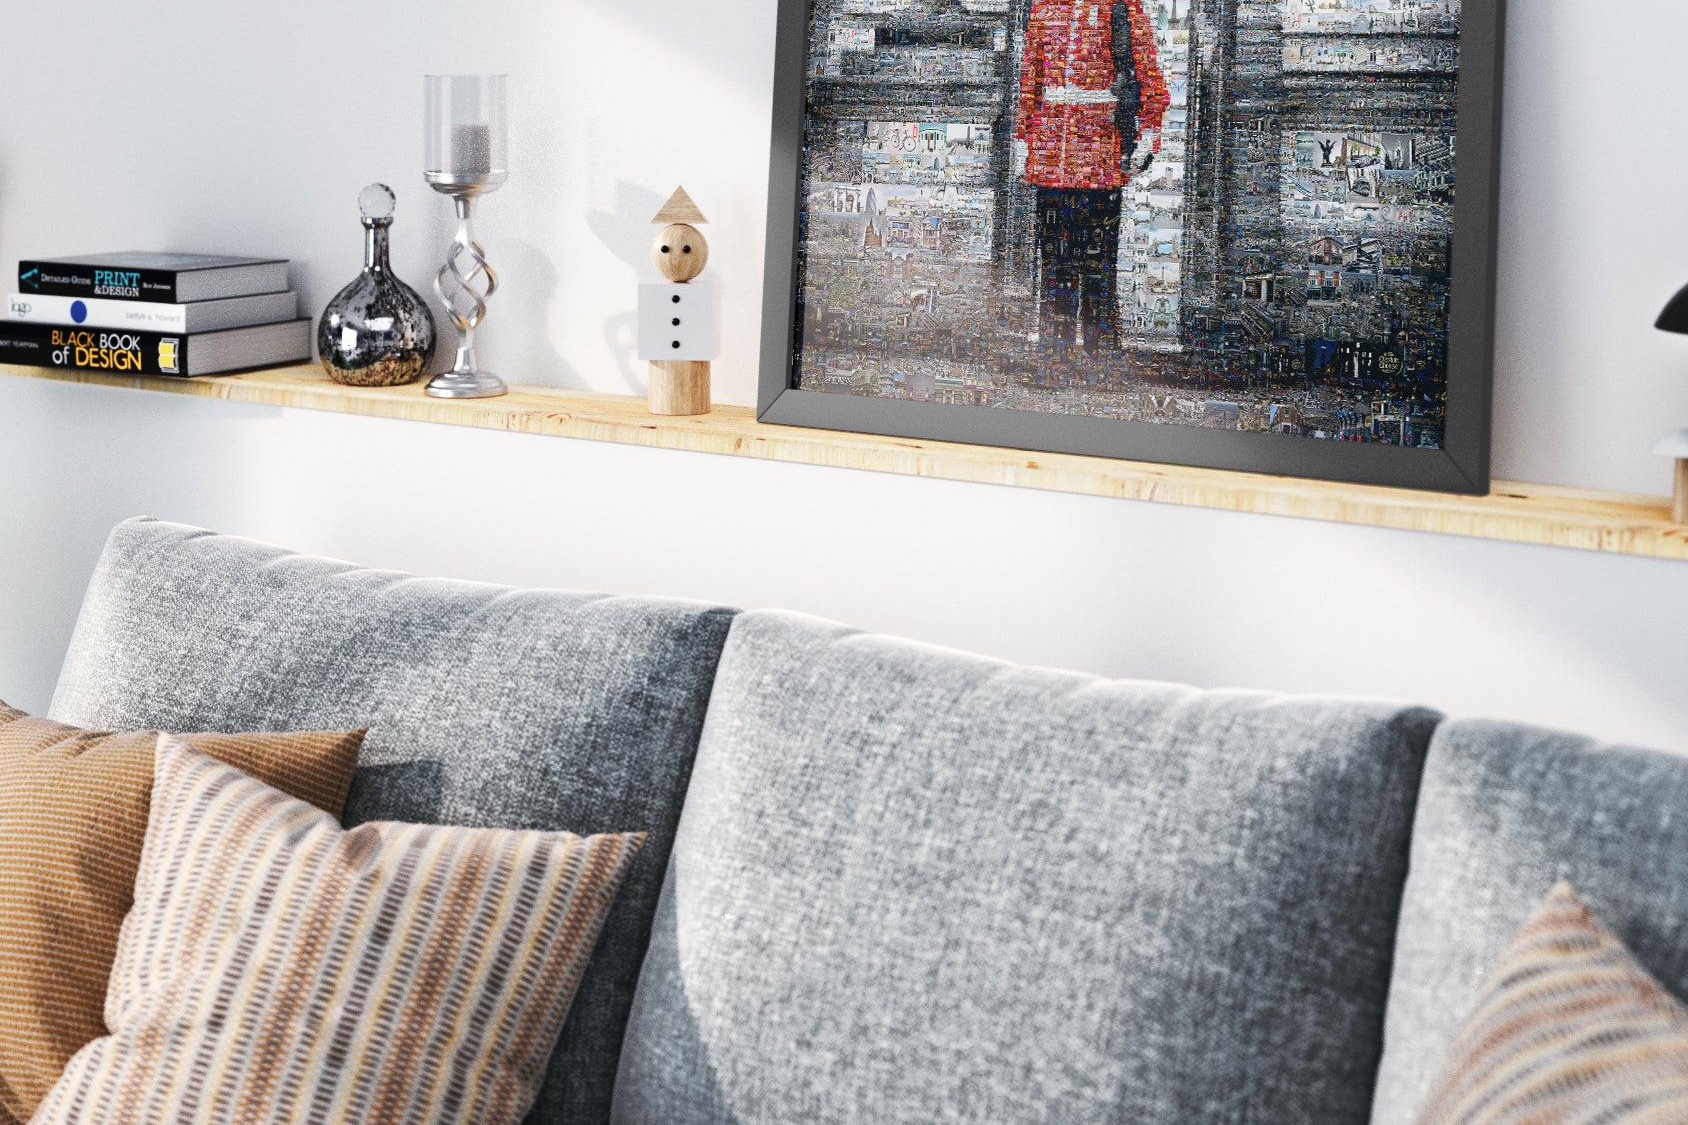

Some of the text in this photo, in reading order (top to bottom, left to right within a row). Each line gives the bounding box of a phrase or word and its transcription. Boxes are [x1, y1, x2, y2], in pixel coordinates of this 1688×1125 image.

[94, 270, 140, 287] PRINT
[51, 330, 95, 347] BLACK
[99, 333, 141, 351] BOOK
[52, 346, 142, 371] of DESIGN
